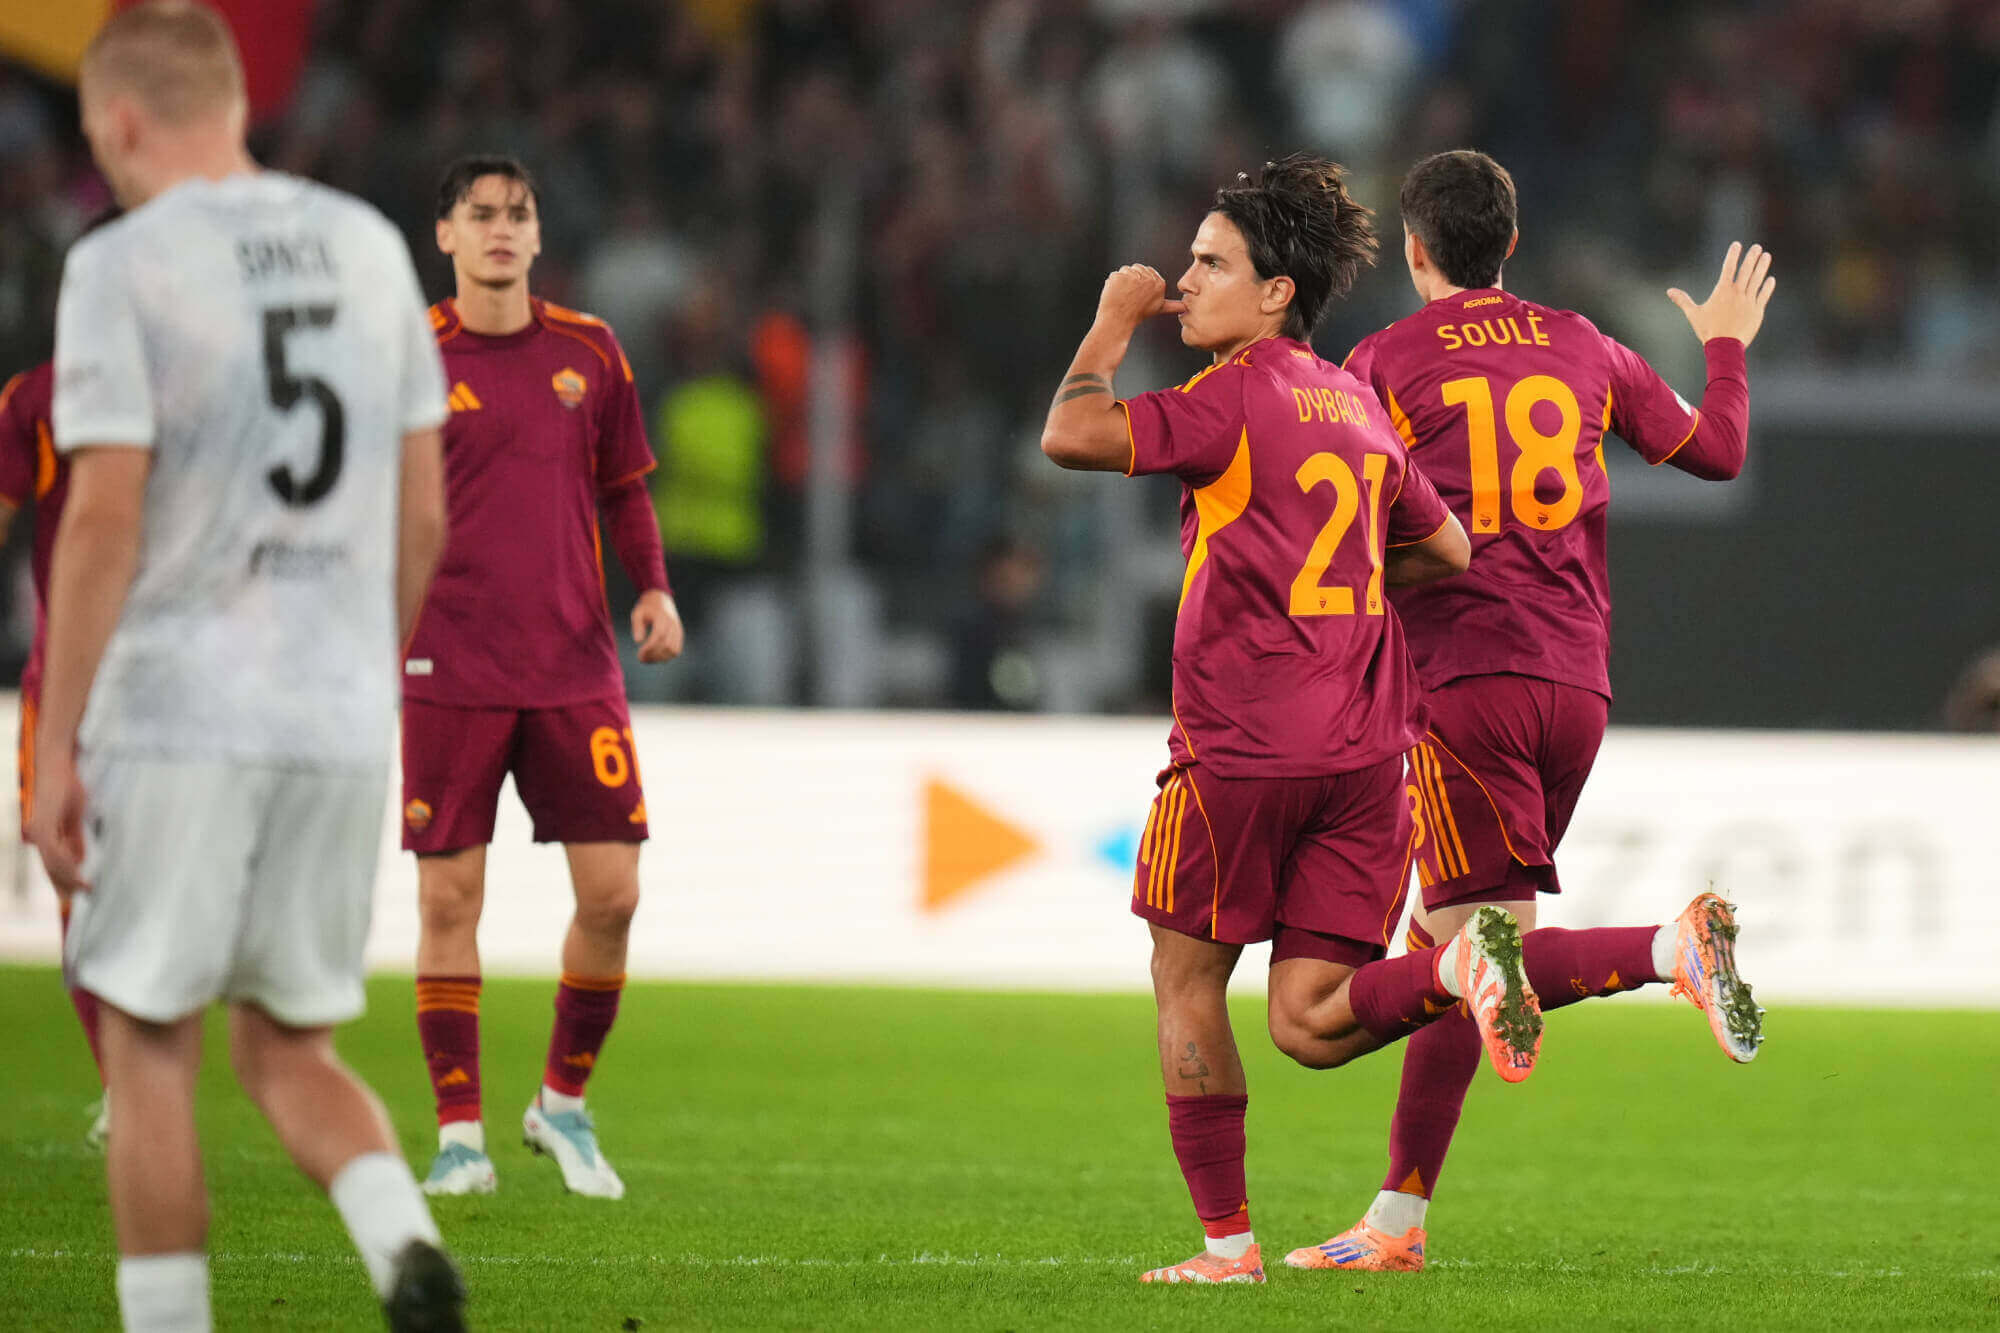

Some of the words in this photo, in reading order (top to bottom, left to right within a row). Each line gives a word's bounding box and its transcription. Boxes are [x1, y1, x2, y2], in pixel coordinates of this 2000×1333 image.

[261, 306, 347, 510] 5
[1291, 386, 1372, 430] DYBALA
[1441, 374, 1584, 535] 18
[1288, 451, 1387, 617] 21
[589, 726, 643, 789] 61
